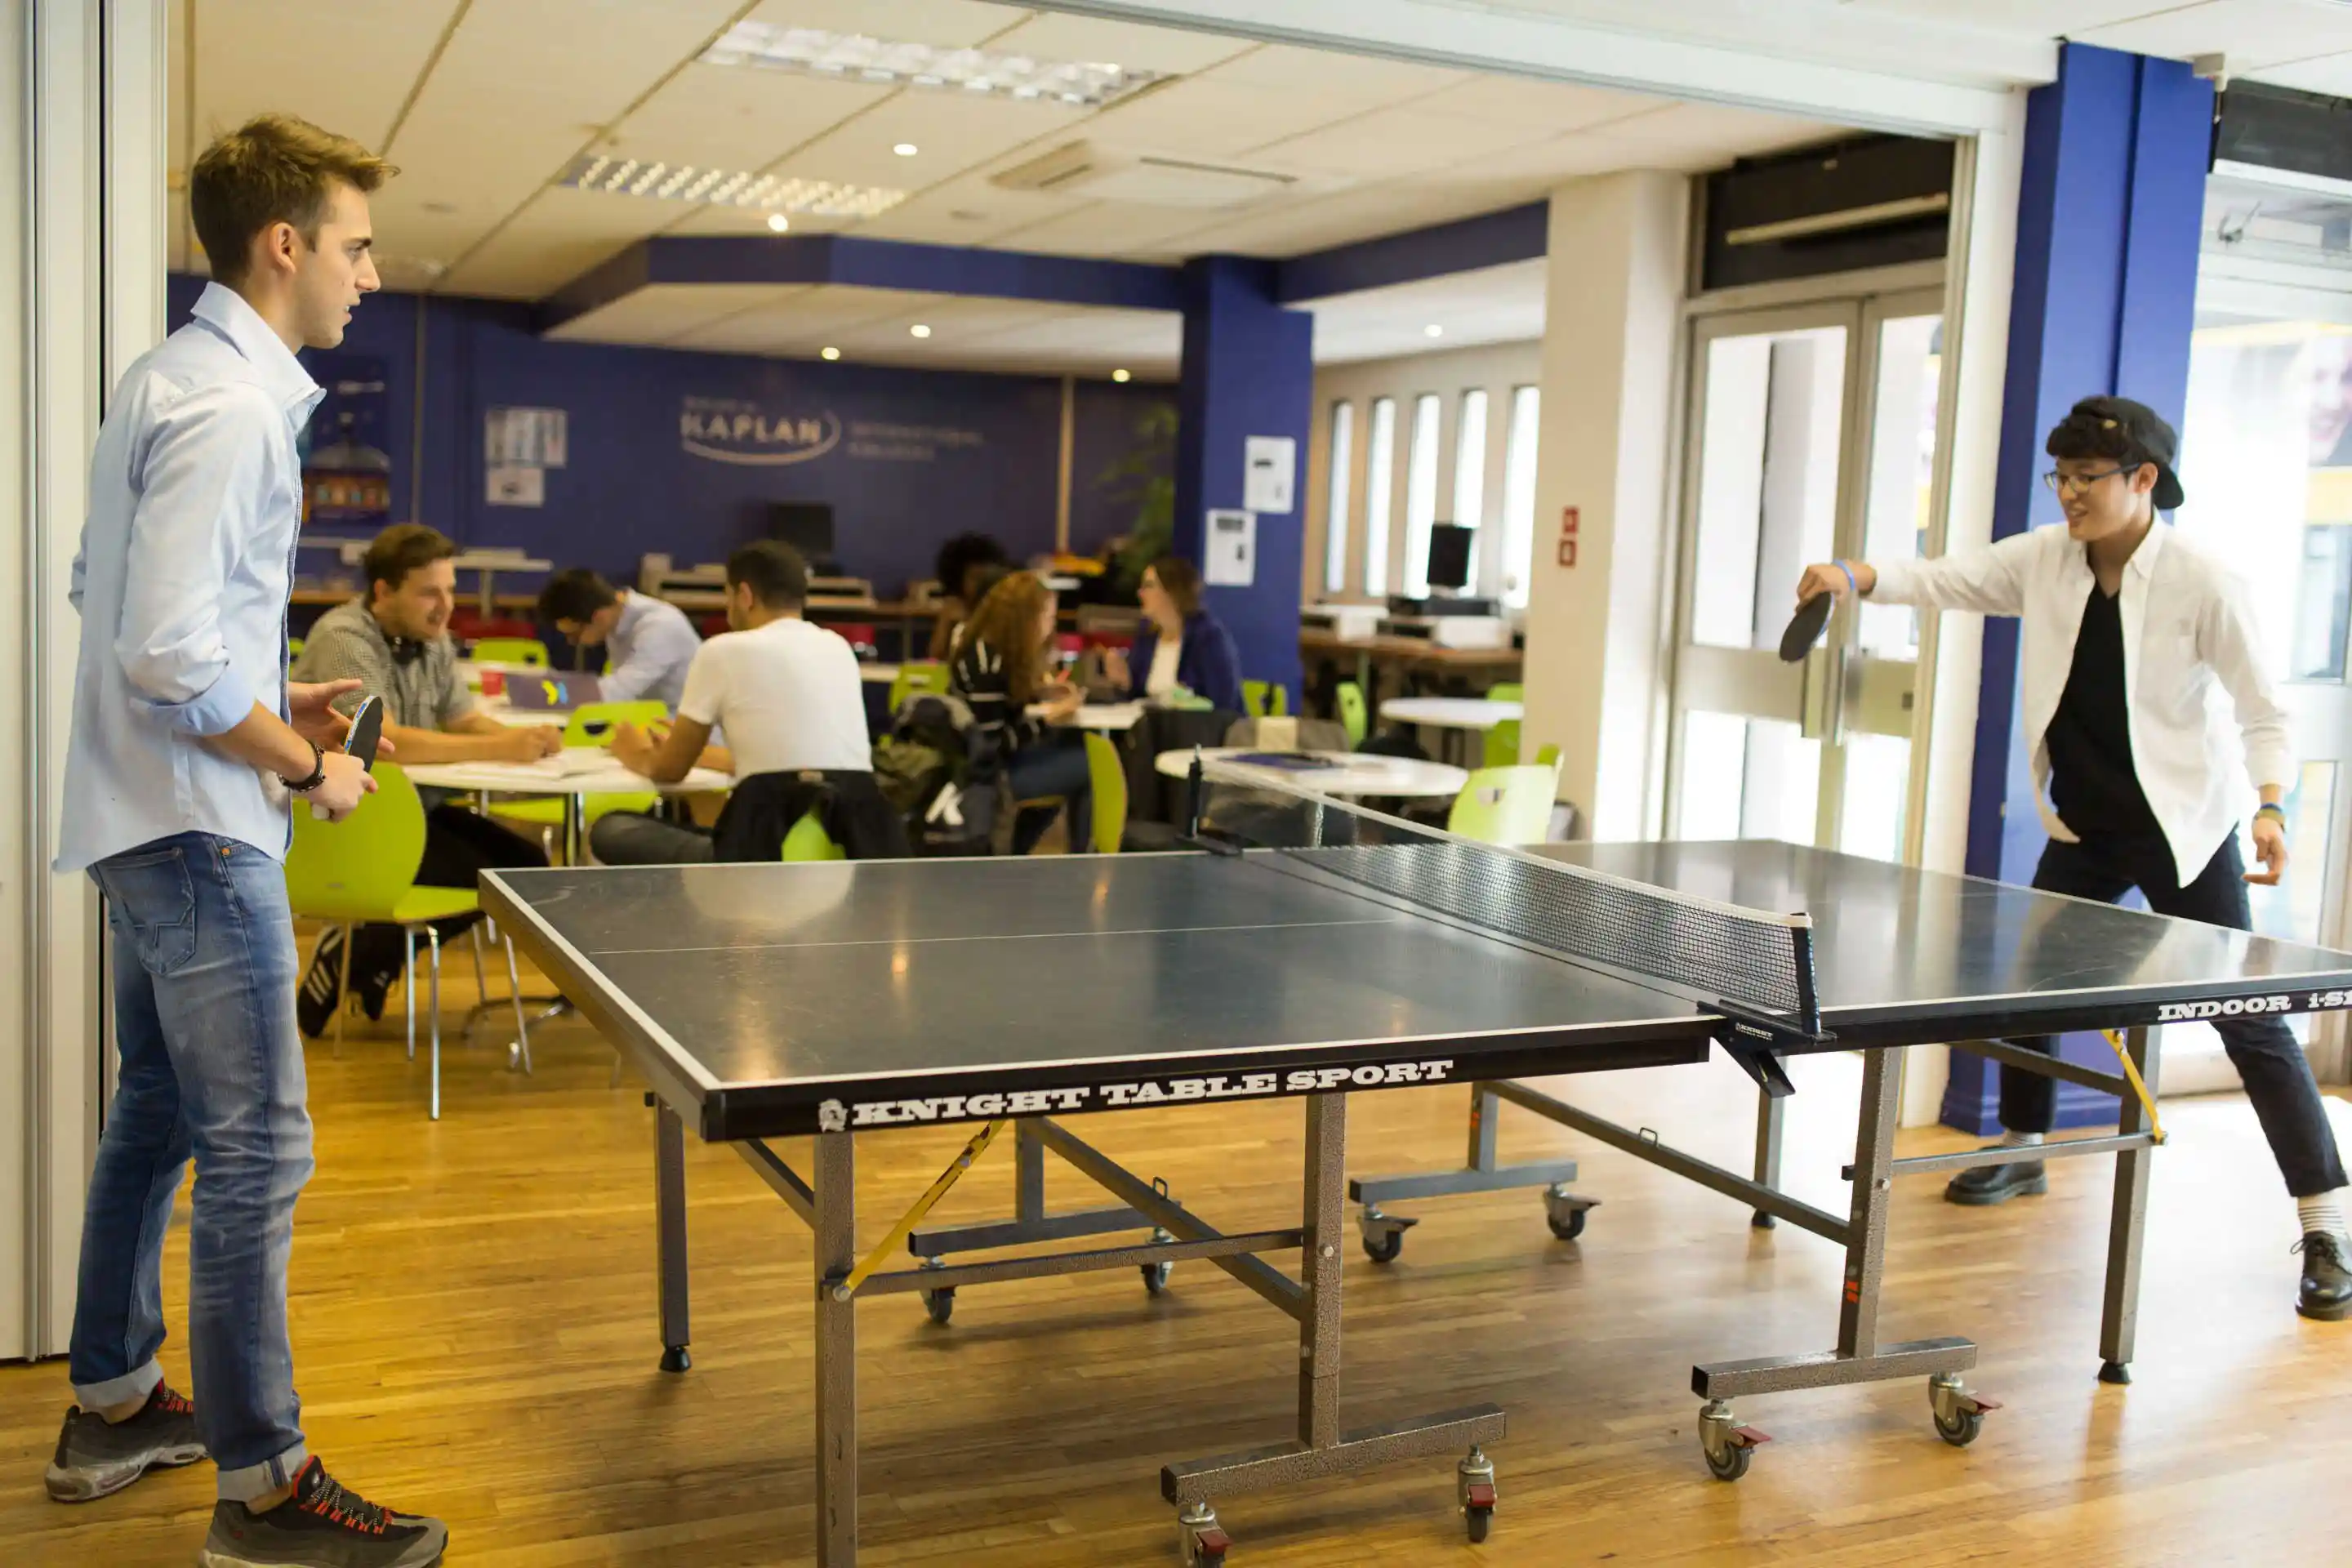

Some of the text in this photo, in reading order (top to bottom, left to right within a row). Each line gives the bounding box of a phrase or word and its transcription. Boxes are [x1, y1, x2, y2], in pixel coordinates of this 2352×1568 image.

[680, 412, 822, 443] KAPLAN
[2158, 996, 2292, 1021] INDOOR
[852, 1060, 1454, 1125] KNIGHT TABLE SPORT
